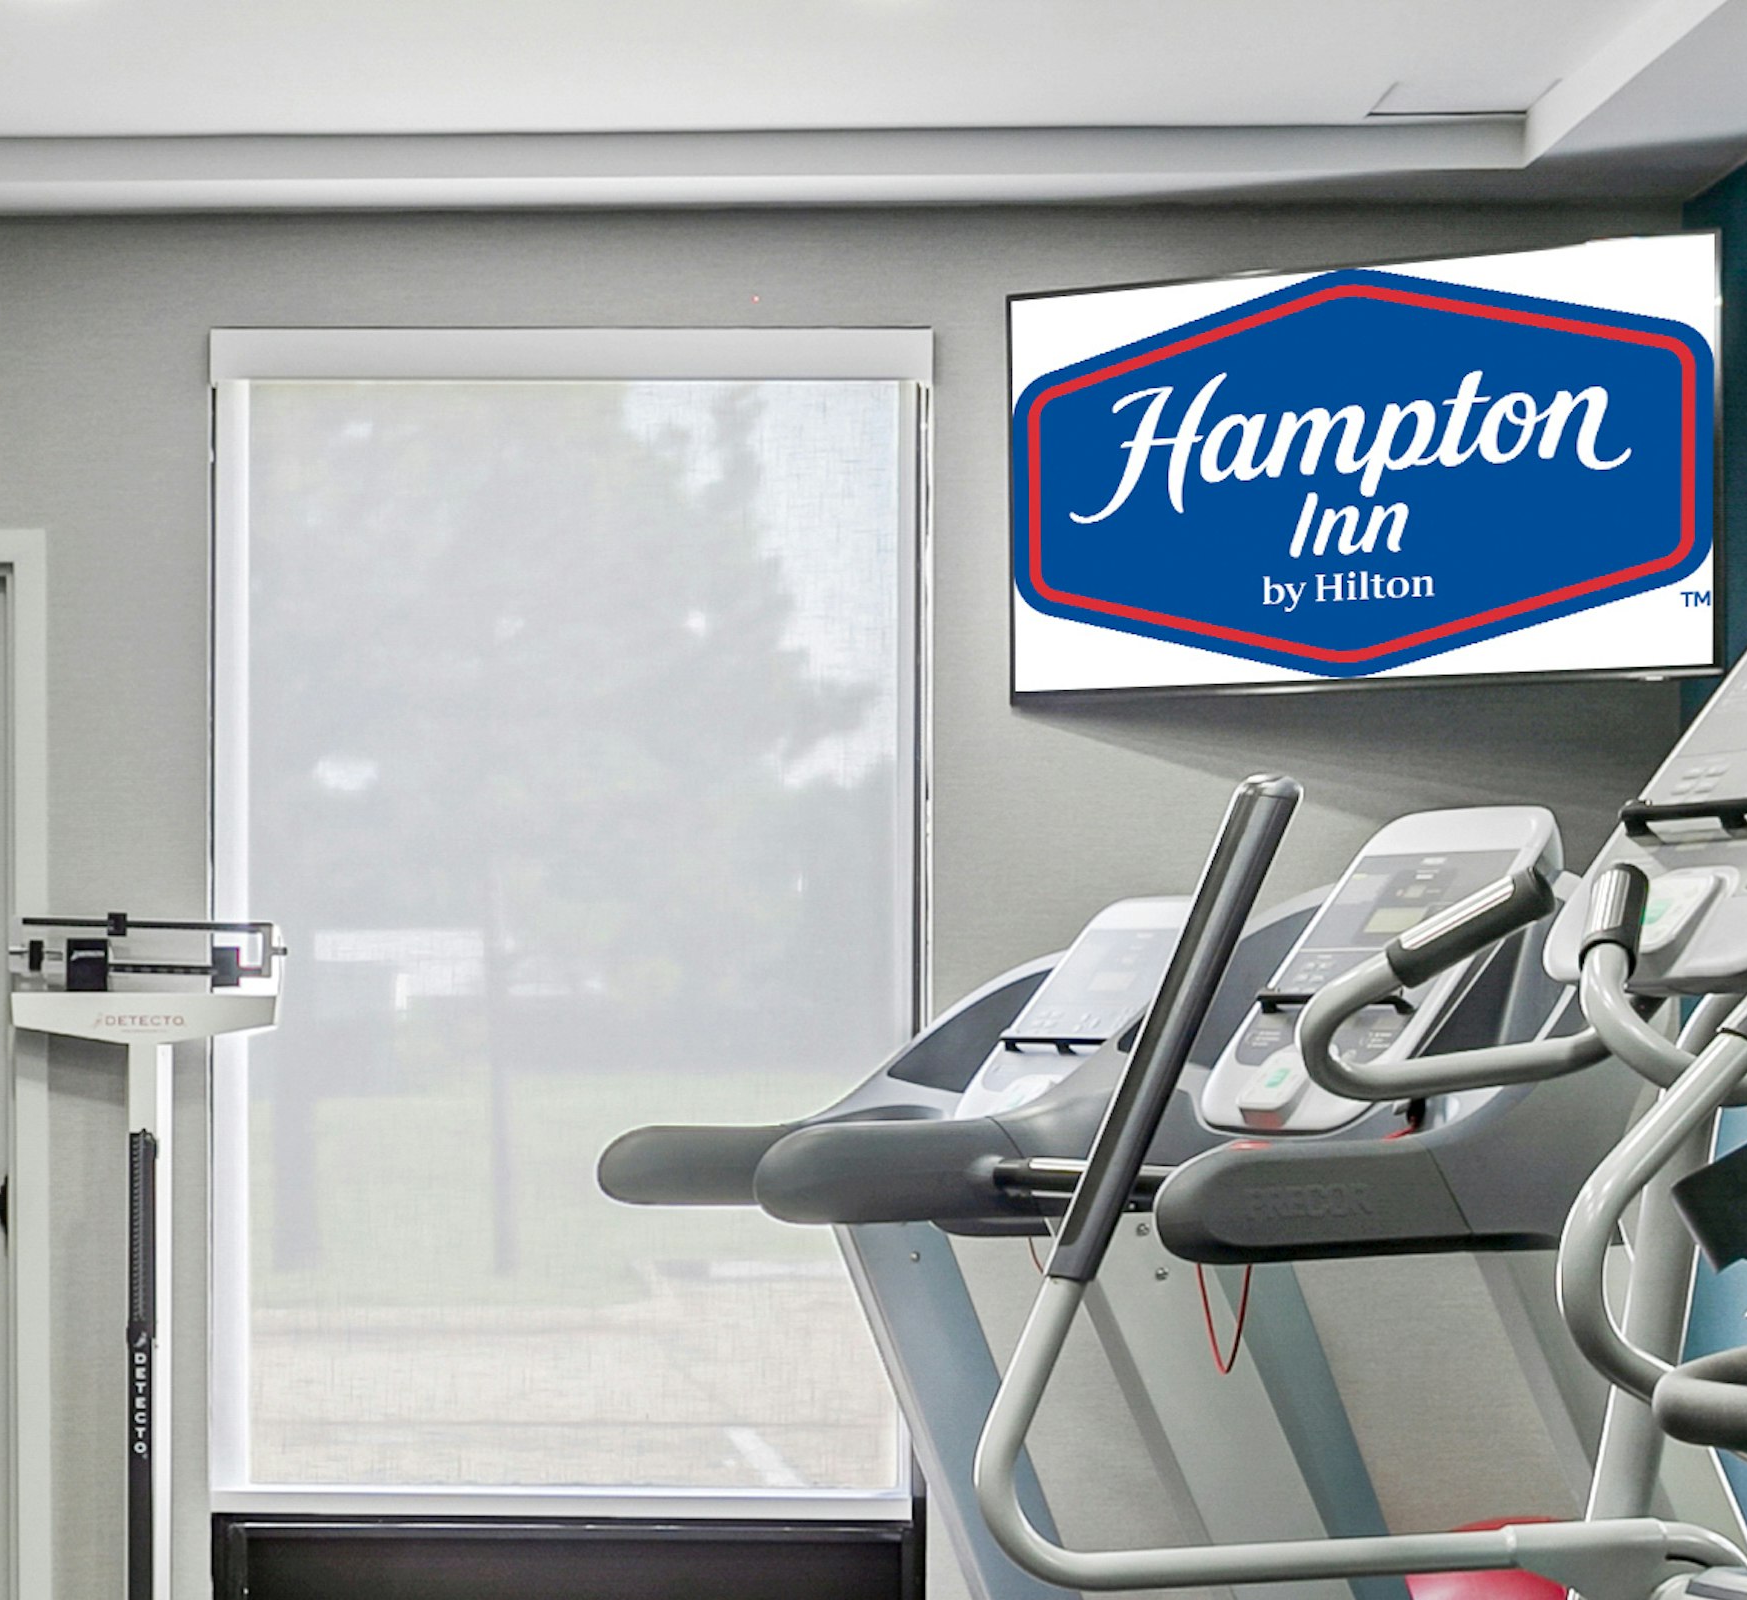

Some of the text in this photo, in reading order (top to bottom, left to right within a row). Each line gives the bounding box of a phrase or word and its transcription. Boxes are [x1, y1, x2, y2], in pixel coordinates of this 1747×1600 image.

[1069, 370, 1633, 525] Hampton
[1289, 492, 1411, 559] Inn
[1262, 570, 1435, 613] by Hilton
[1680, 590, 1711, 608] TM
[105, 1014, 186, 1027] DETECTO
[133, 1352, 148, 1454] DETECTO
